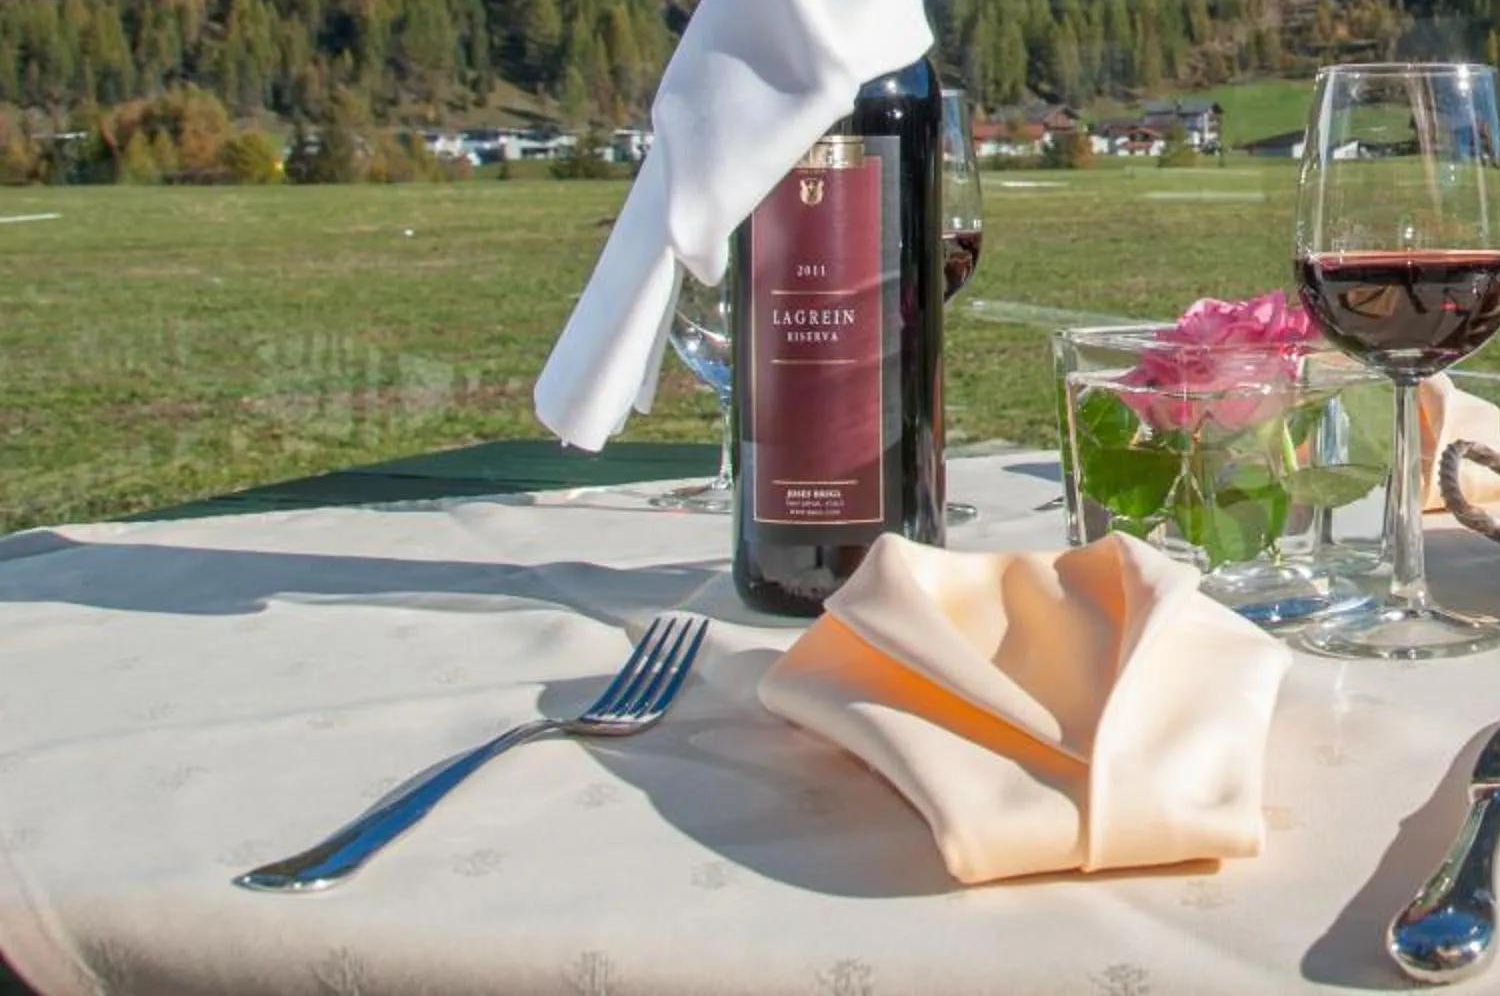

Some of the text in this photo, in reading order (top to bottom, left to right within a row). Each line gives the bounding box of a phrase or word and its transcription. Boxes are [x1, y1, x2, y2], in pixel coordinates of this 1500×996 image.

[797, 264, 825, 277] 2011
[773, 309, 854, 325] LAGREIN
[787, 331, 839, 342] RISERVA
